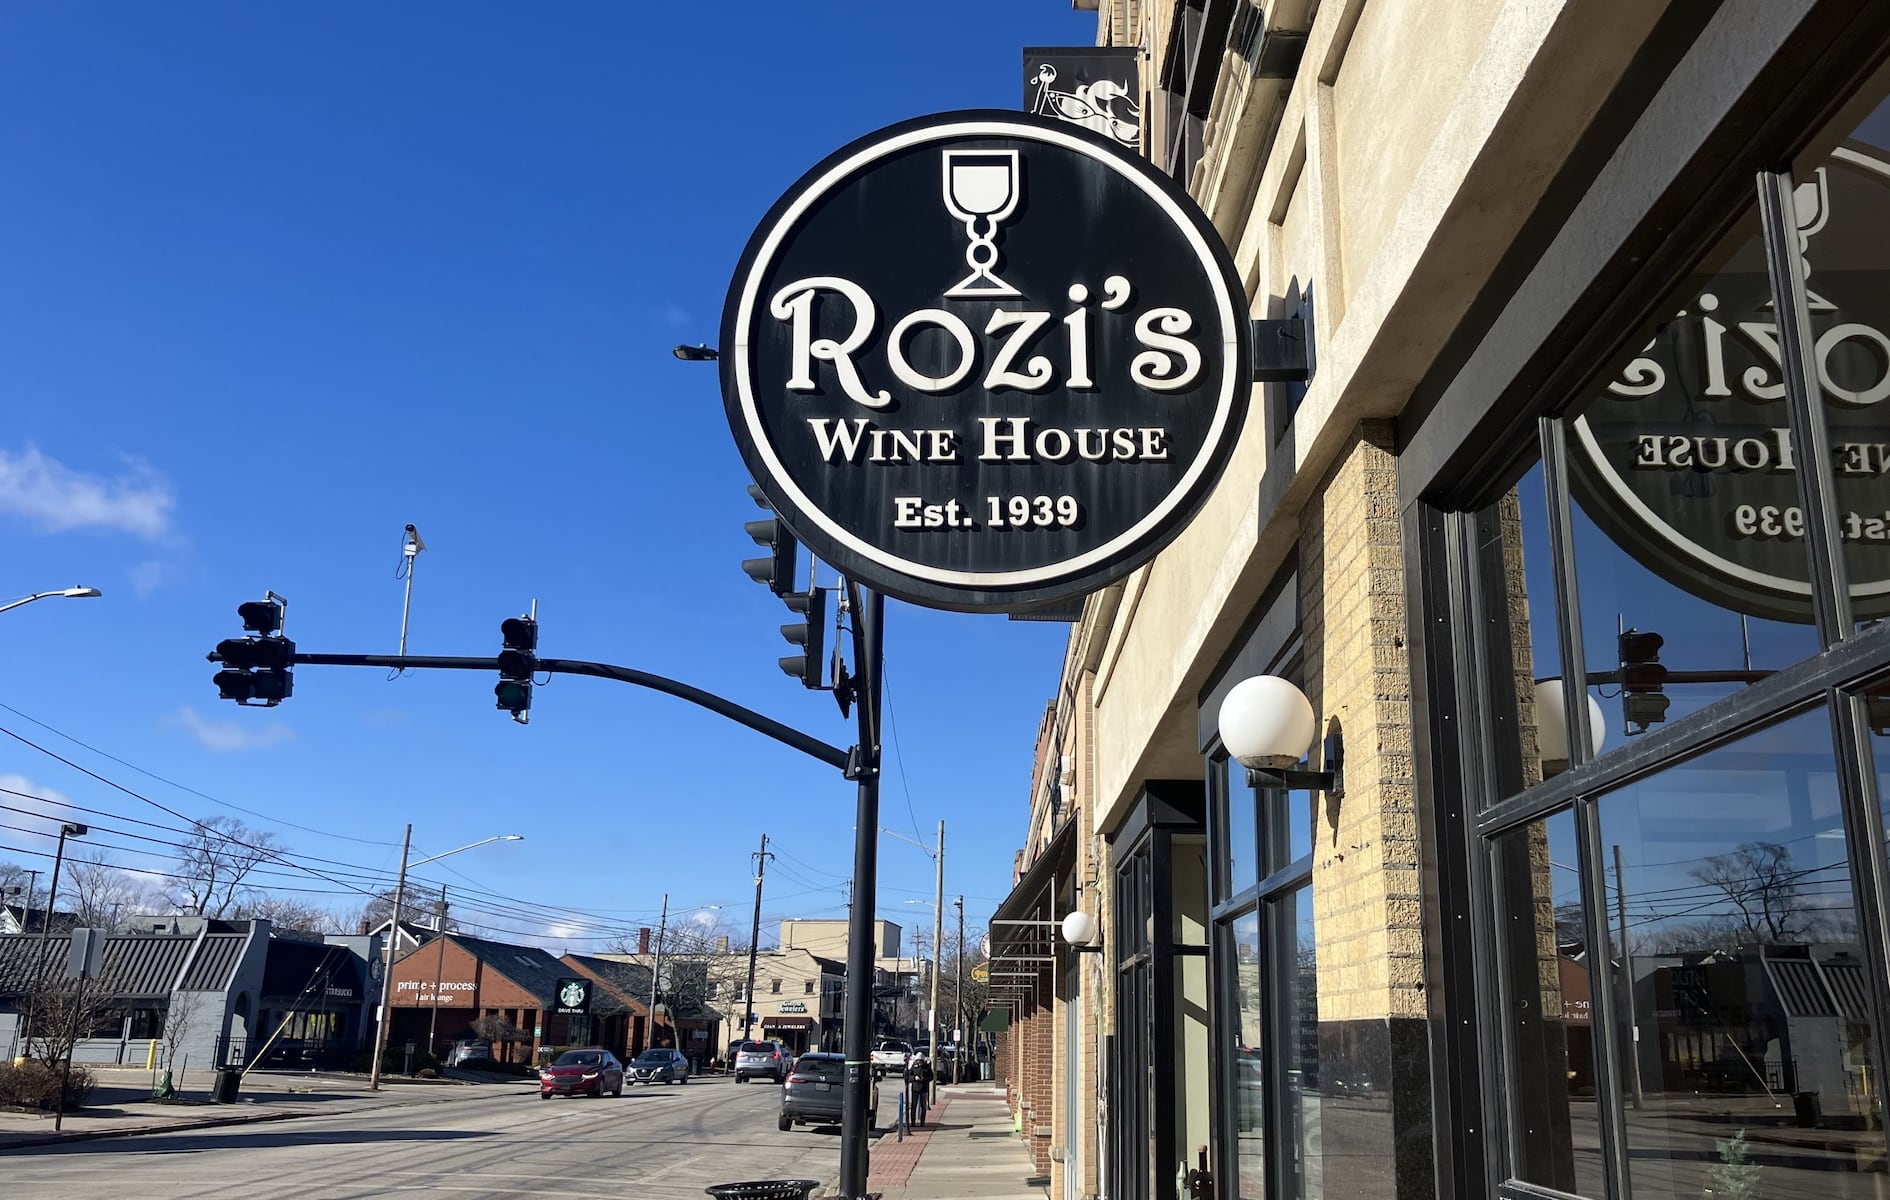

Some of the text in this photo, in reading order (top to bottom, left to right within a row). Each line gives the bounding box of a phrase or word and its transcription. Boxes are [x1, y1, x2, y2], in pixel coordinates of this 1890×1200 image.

[771, 275, 1202, 407] Rozi's
[894, 495, 1078, 527] Est. 1939
[439, 981, 478, 992] process
